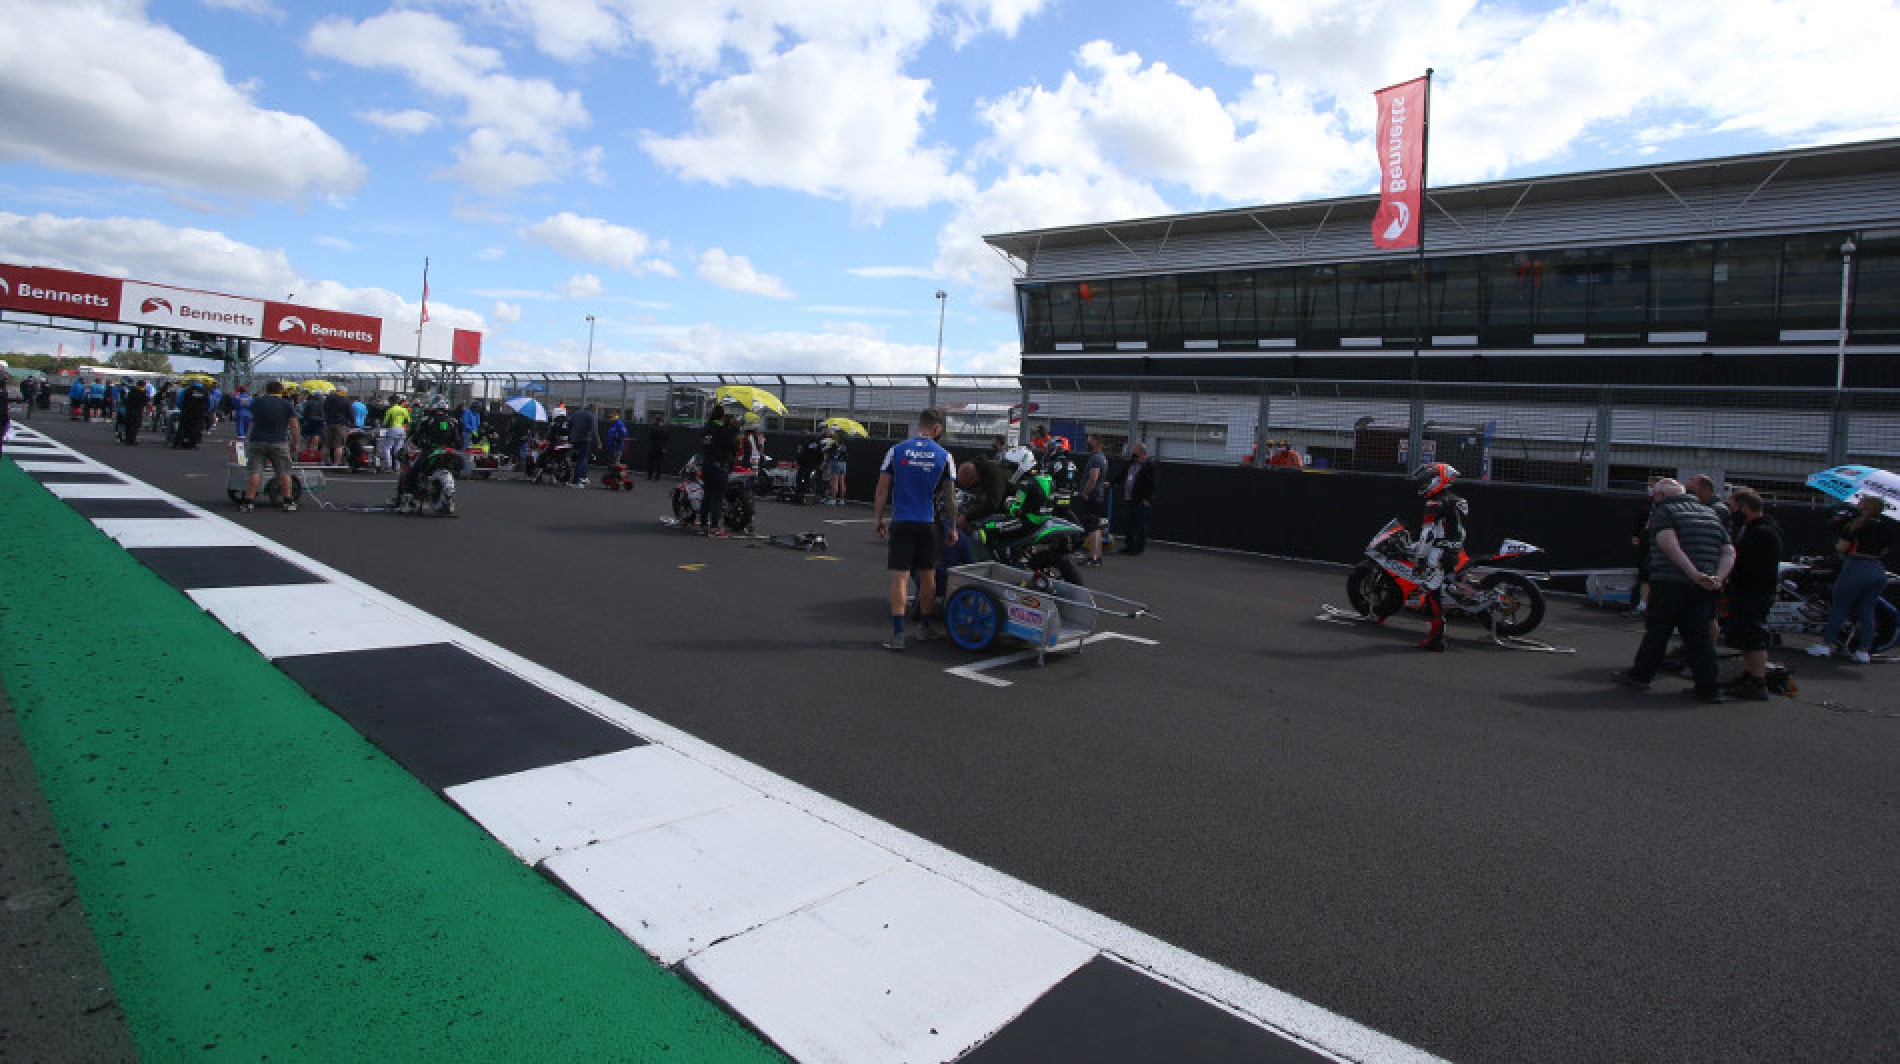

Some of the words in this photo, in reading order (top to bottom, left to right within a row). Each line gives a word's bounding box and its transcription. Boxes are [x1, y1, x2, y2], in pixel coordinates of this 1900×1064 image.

[17, 283, 109, 307] Bennetts
[179, 305, 254, 326] Bennetts
[311, 323, 373, 343] Bennetts
